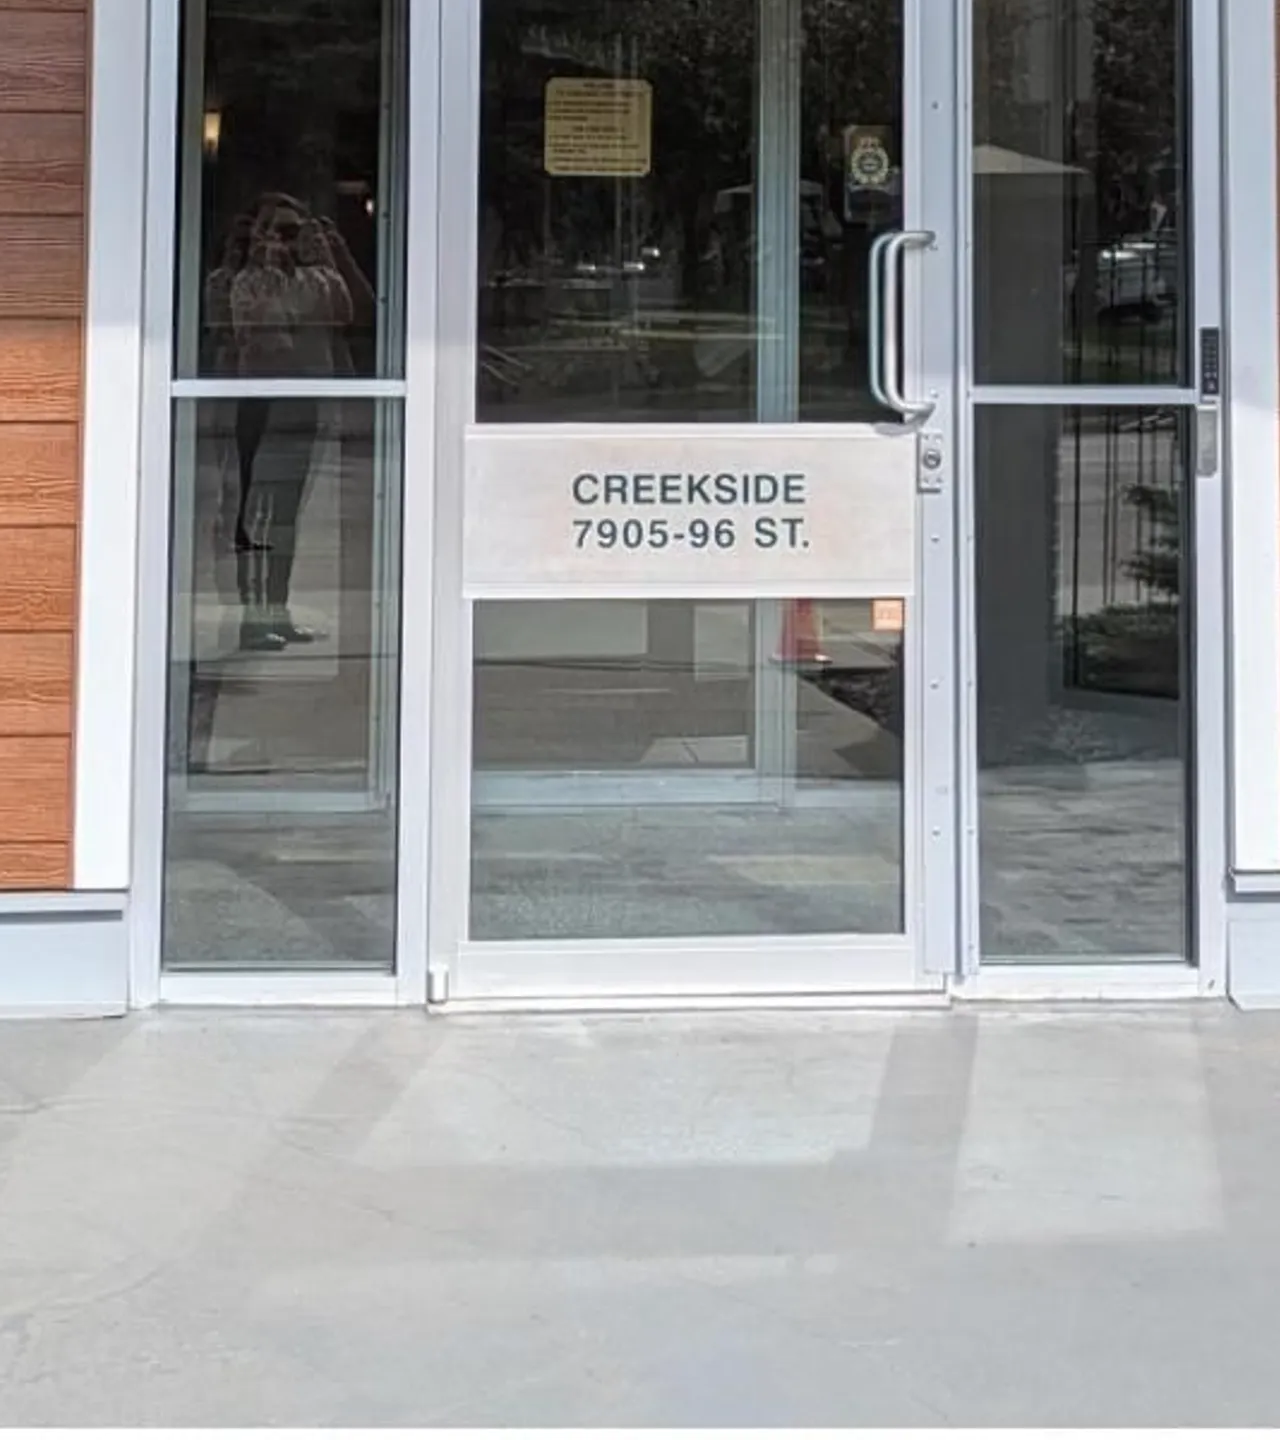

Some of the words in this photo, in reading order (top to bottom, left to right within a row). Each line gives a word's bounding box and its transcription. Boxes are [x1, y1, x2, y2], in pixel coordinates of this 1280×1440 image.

[572, 474, 806, 504] CREEKSIDE
[572, 519, 736, 549] 7905-96
[754, 518, 810, 548] ST.
